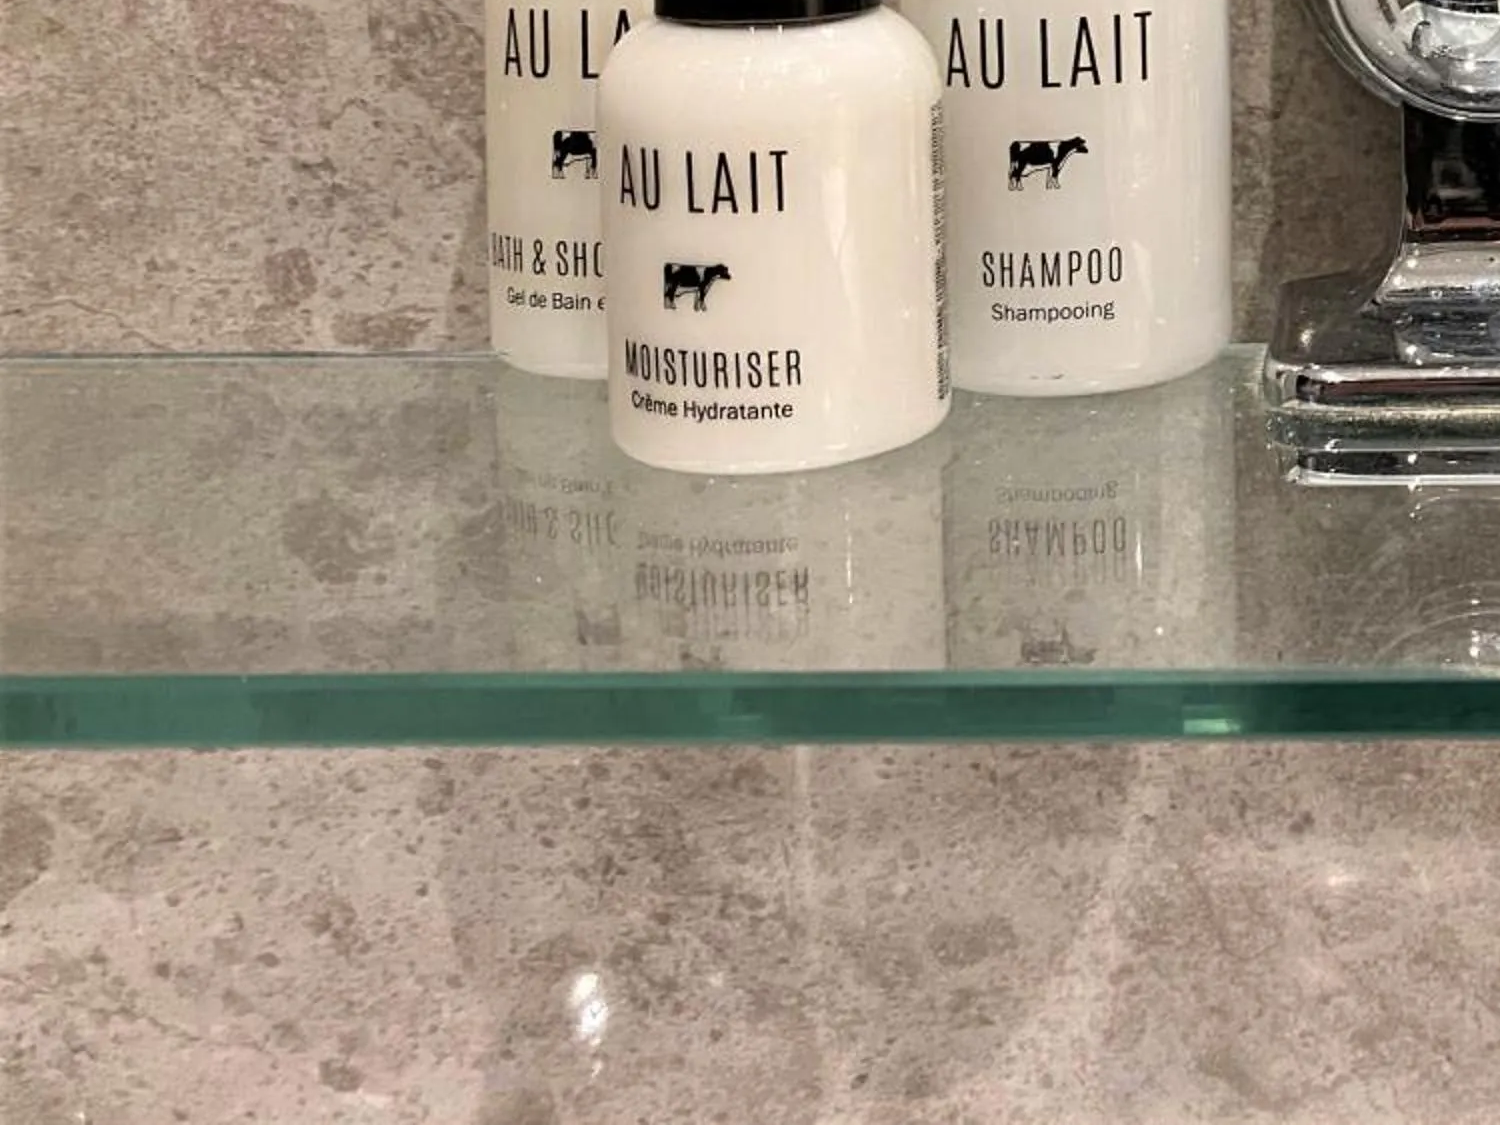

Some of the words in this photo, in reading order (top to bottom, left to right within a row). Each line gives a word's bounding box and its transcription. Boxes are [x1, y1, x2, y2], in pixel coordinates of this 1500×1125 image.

[504, 7, 549, 78] AU
[946, 16, 1006, 89] AU
[1039, 10, 1153, 88] LAIT
[620, 144, 662, 210] AU
[685, 148, 789, 214] LAIT
[532, 238, 547, 275] &
[981, 245, 1123, 288] SHAMPOO
[507, 286, 526, 306] Gel
[529, 290, 547, 308] de
[552, 292, 591, 310] Bain
[991, 301, 1116, 324] Shampooing
[625, 338, 802, 389] MOISTURISER
[631, 390, 678, 416] Crème
[683, 399, 794, 424] Hydratante
